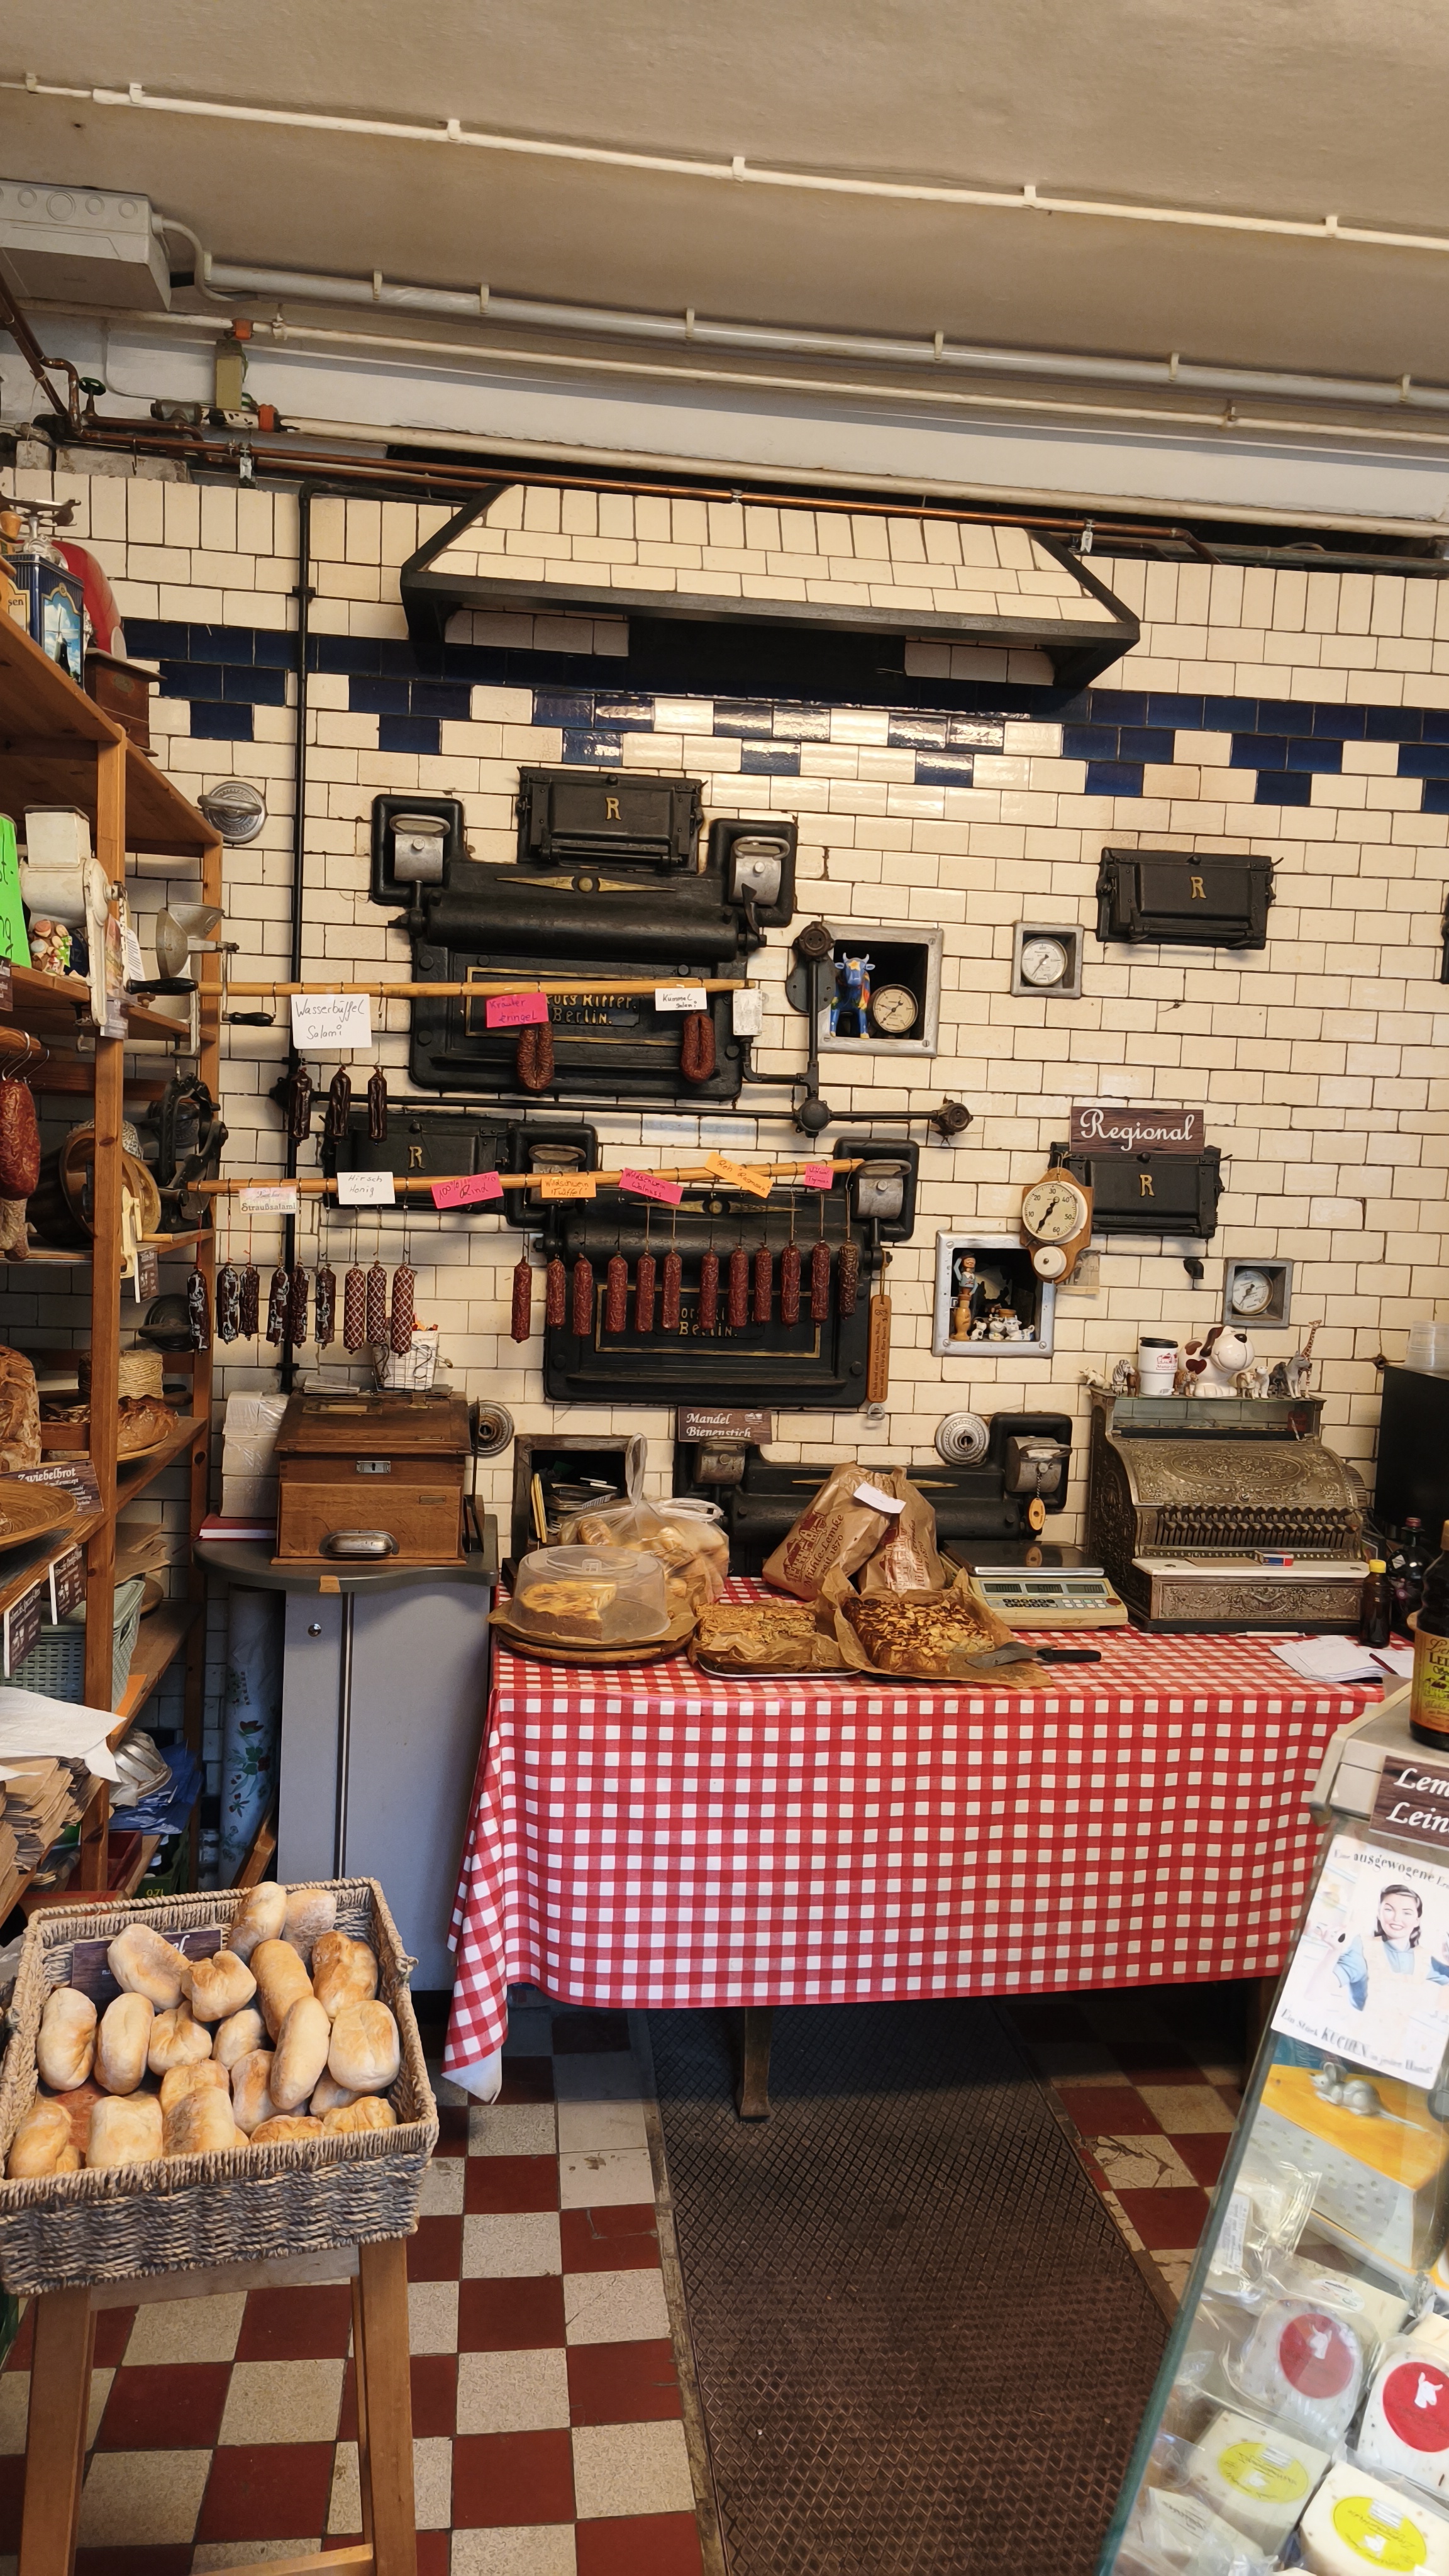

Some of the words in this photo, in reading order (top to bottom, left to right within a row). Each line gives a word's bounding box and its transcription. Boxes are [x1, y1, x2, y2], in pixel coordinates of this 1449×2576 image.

[606, 797, 621, 821] R
[1191, 876, 1207, 899] R
[296, 998, 365, 1023] Wasserbüffel
[306, 1024, 342, 1040] Salami
[1080, 1109, 1195, 1151] Regional
[408, 1146, 426, 1170] R
[349, 1186, 375, 1197] Honig
[460, 1183, 489, 1199] Rind
[1140, 1174, 1155, 1197] R
[686, 1413, 733, 1424] Mandel
[686, 1426, 752, 1438] Bienenstich
[18, 1467, 76, 1482] Zwiebelbrot
[804, 1514, 845, 1589] Mühle-Lemke
[821, 1557, 832, 1574] seit
[830, 1535, 844, 1555] 1870
[1353, 1853, 1435, 1883] ausgewogene
[1321, 2026, 1369, 2058] KUCHEN
